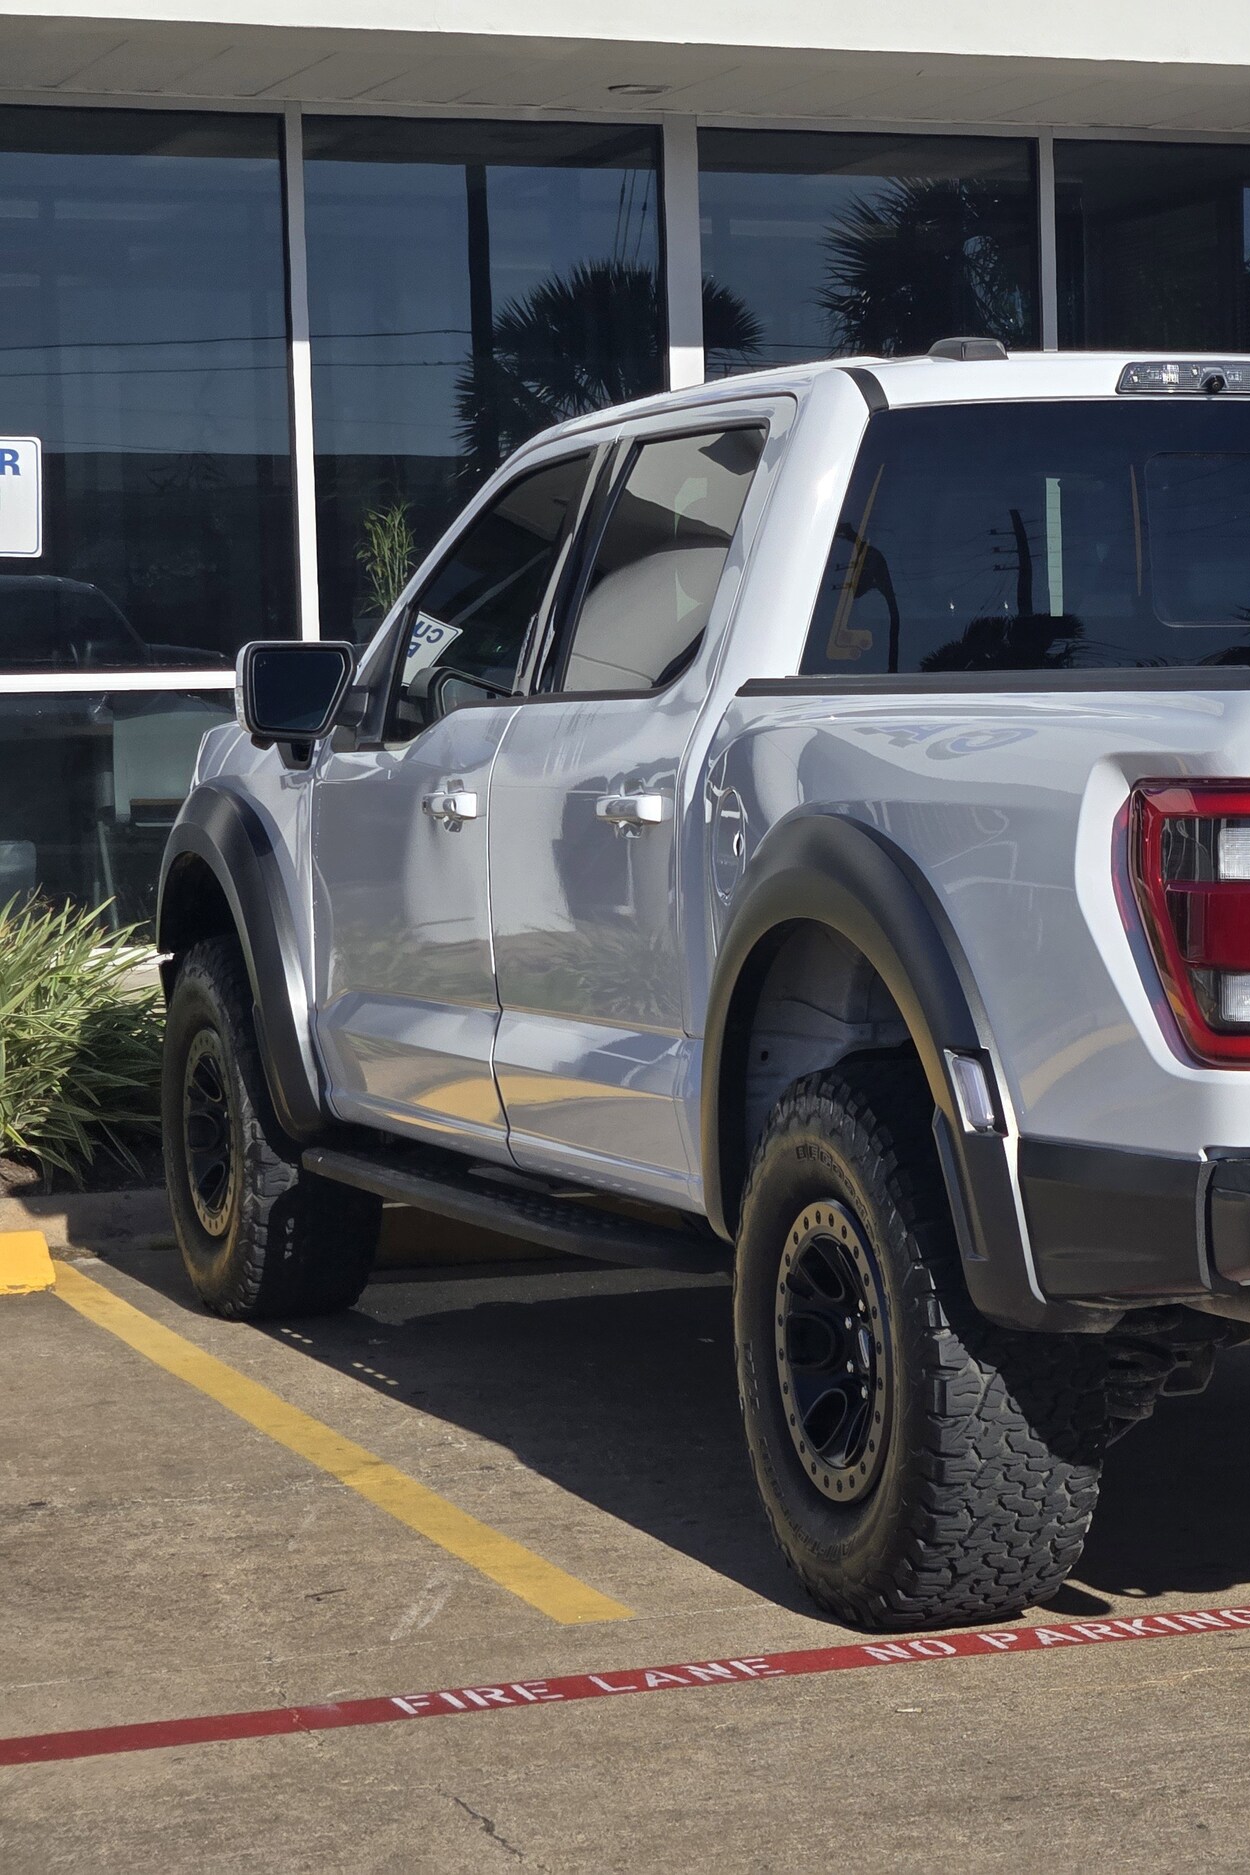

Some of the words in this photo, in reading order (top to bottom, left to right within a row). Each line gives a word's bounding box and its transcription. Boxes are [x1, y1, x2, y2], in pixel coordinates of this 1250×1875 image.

[391, 1681, 564, 1715] FIRE
[589, 1658, 786, 1693] LANE
[862, 1640, 956, 1662] NO
